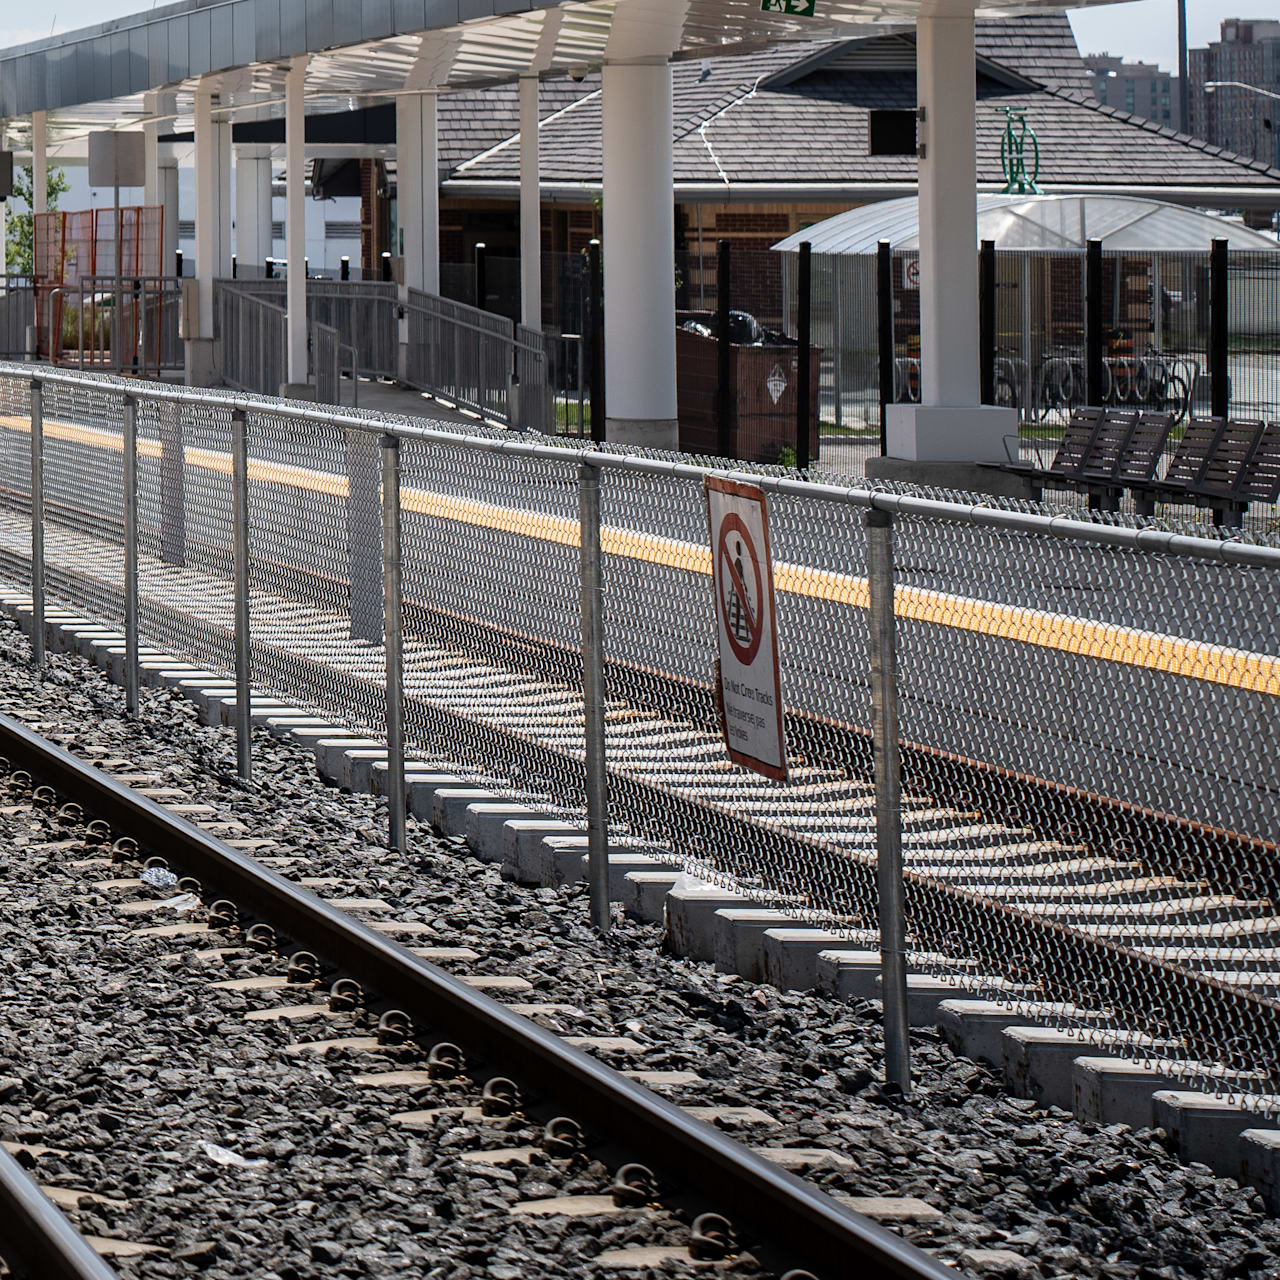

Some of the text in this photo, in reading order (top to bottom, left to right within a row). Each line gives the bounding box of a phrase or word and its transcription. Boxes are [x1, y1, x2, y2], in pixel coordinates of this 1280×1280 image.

[731, 680, 740, 695] Not
[741, 683, 755, 700] Cross
[755, 688, 773, 706] Tracks
